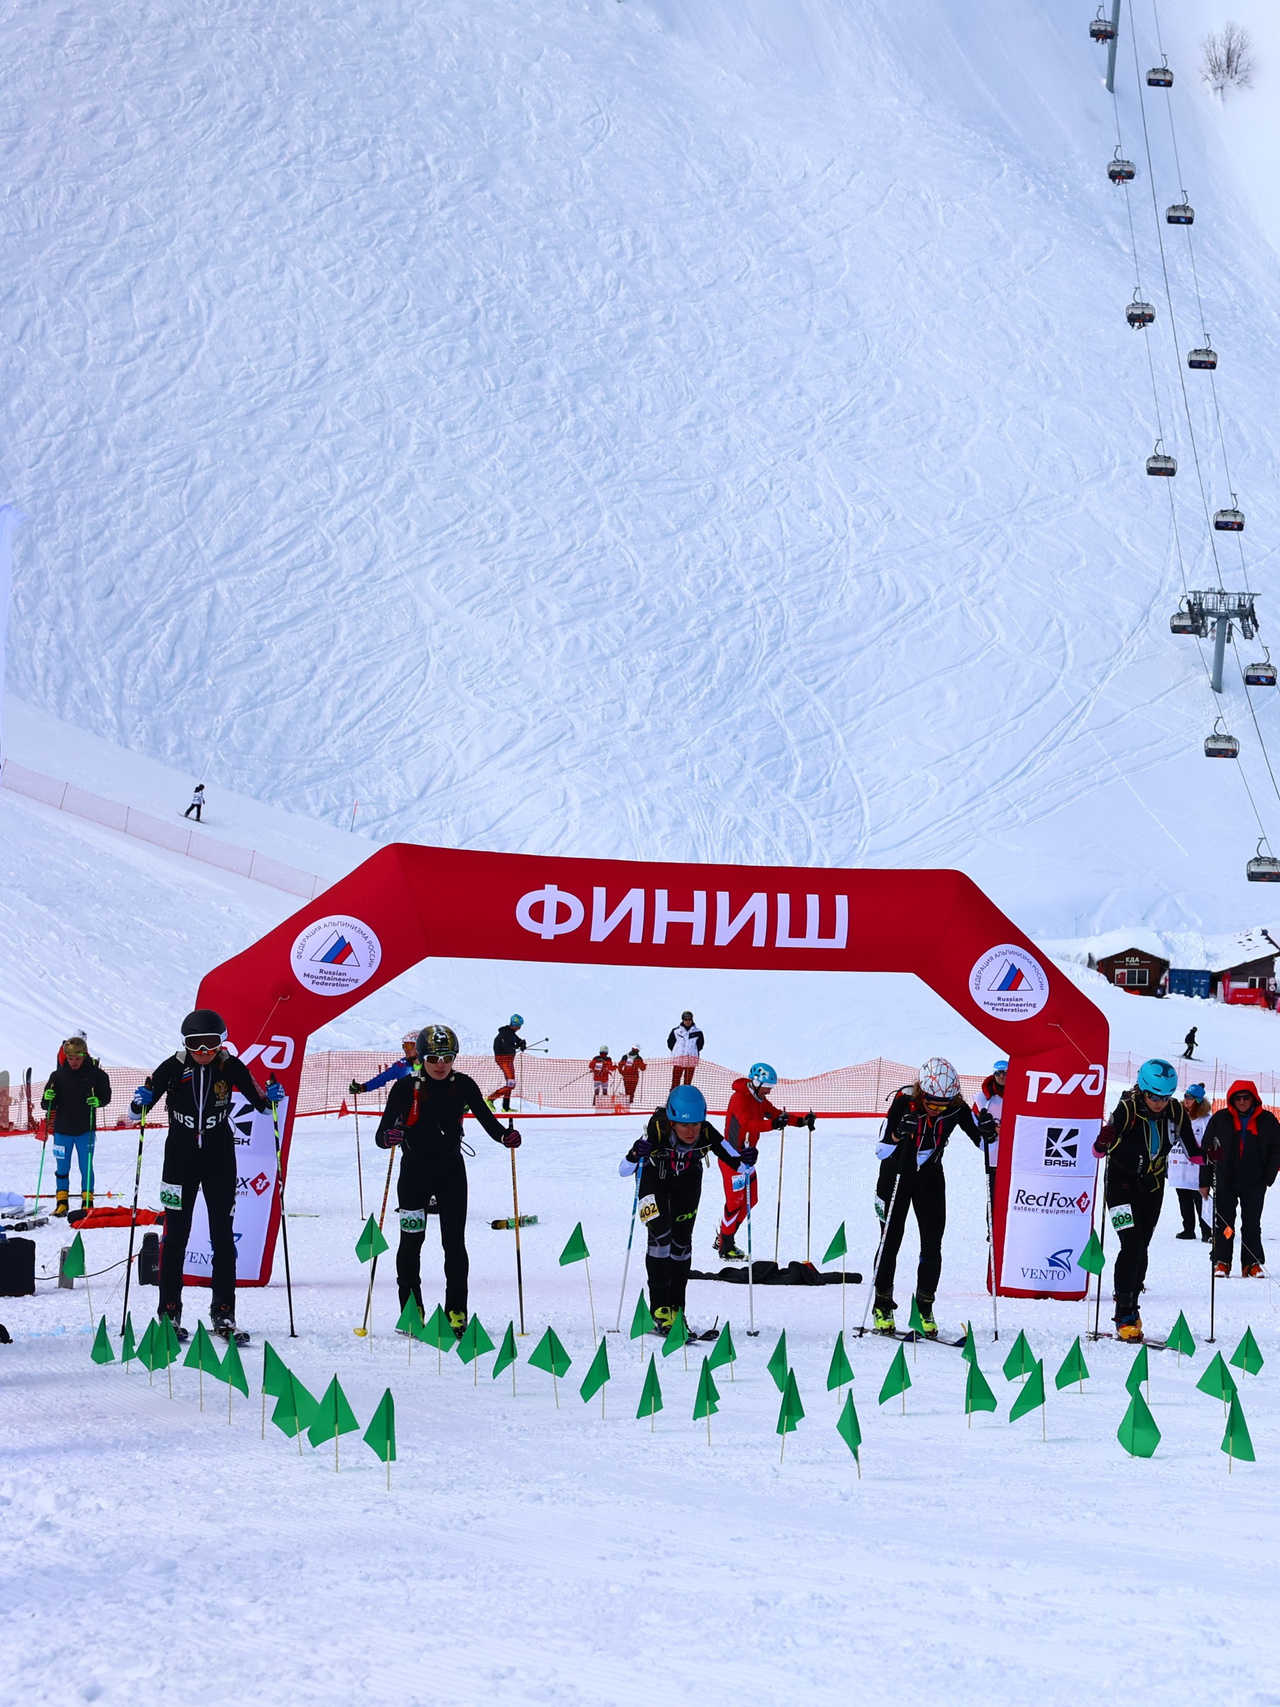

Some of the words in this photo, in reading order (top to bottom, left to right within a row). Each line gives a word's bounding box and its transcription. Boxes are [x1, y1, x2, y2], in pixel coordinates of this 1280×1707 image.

[515, 884, 849, 949] ФИНИШ
[296, 926, 323, 960] ФЕДЕРАЦИЯ
[323, 920, 369, 941] АЛЬПИНИЗМА
[366, 940, 376, 968] РОССИИ
[319, 968, 347, 977] Russian
[974, 955, 995, 991] ФЕДЕРАЦИЯ
[994, 949, 1033, 966] АЛЬПИНИЗМА
[1031, 964, 1045, 991] РОССИИ
[303, 972, 359, 984] Mountaineering
[311, 979, 350, 988] Federation
[1025, 1064, 1105, 1103] РЖД
[233, 1137, 251, 1146] SK
[1044, 1158, 1077, 1168] BASK
[160, 1191, 180, 1205] 223
[1014, 1188, 1077, 1208] RedFox
[640, 1202, 658, 1219] 402
[1013, 1205, 1039, 1213] outdoor
[400, 1218, 423, 1229] 201
[1111, 1212, 1132, 1227] 209
[1020, 1266, 1066, 1281] VENTO
